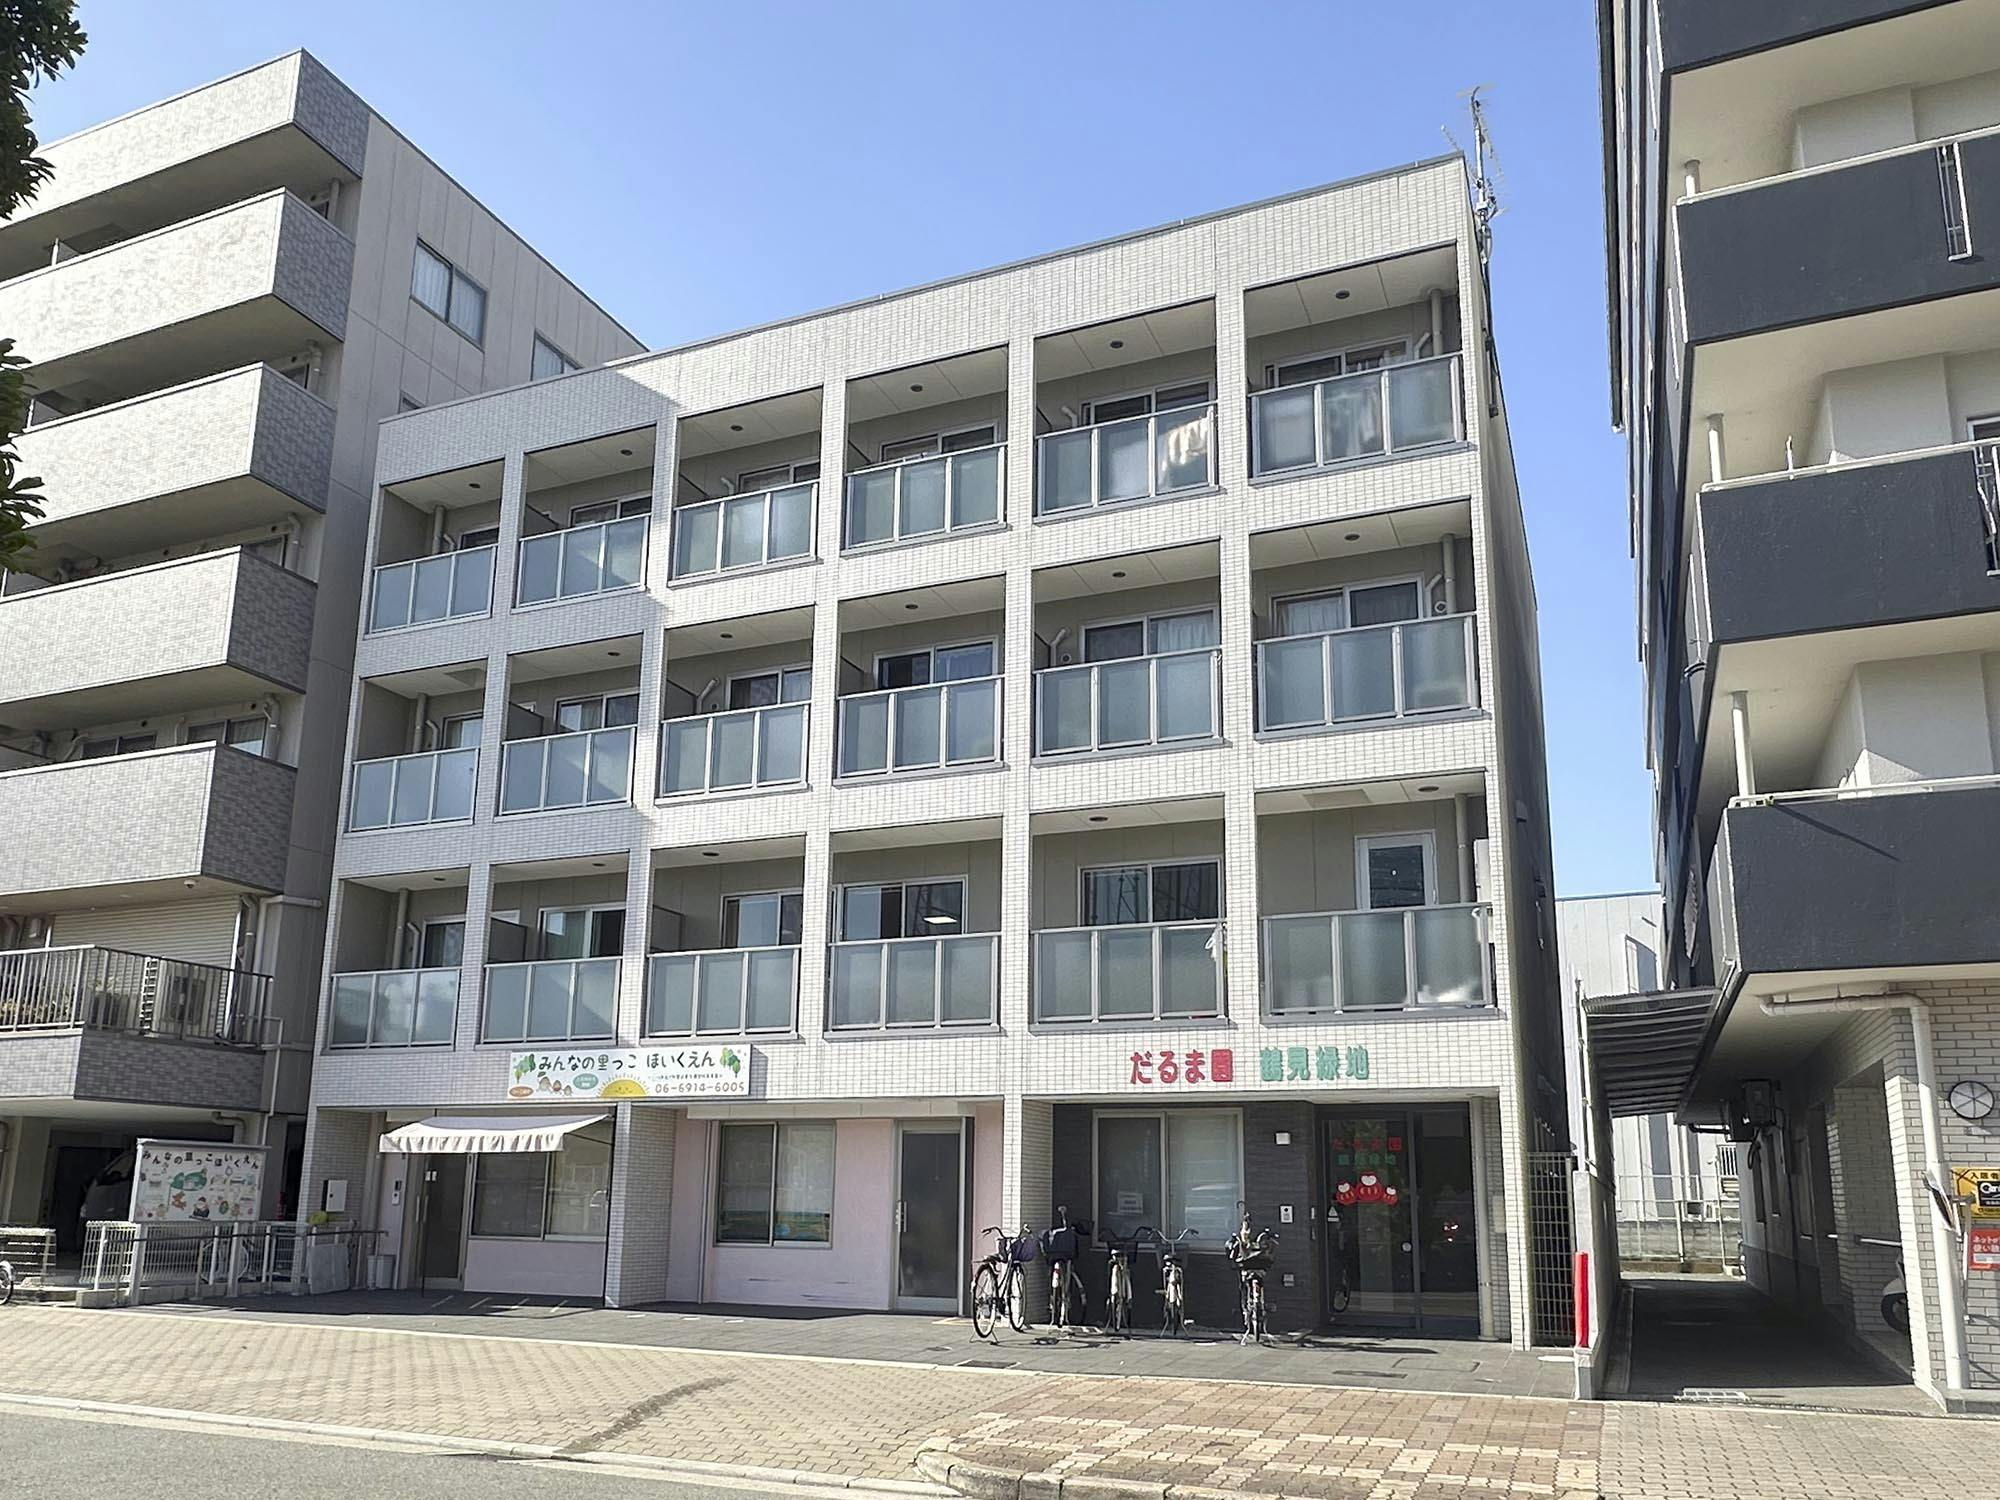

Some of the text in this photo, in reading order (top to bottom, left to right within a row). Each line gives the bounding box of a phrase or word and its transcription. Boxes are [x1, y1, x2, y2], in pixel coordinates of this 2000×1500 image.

[538, 1051, 715, 1071] みんなの里っこ ほいくえん
[1130, 1045, 1370, 1084] だるま園 鶴見緑地
[655, 1081, 745, 1094] 06-6914-6005
